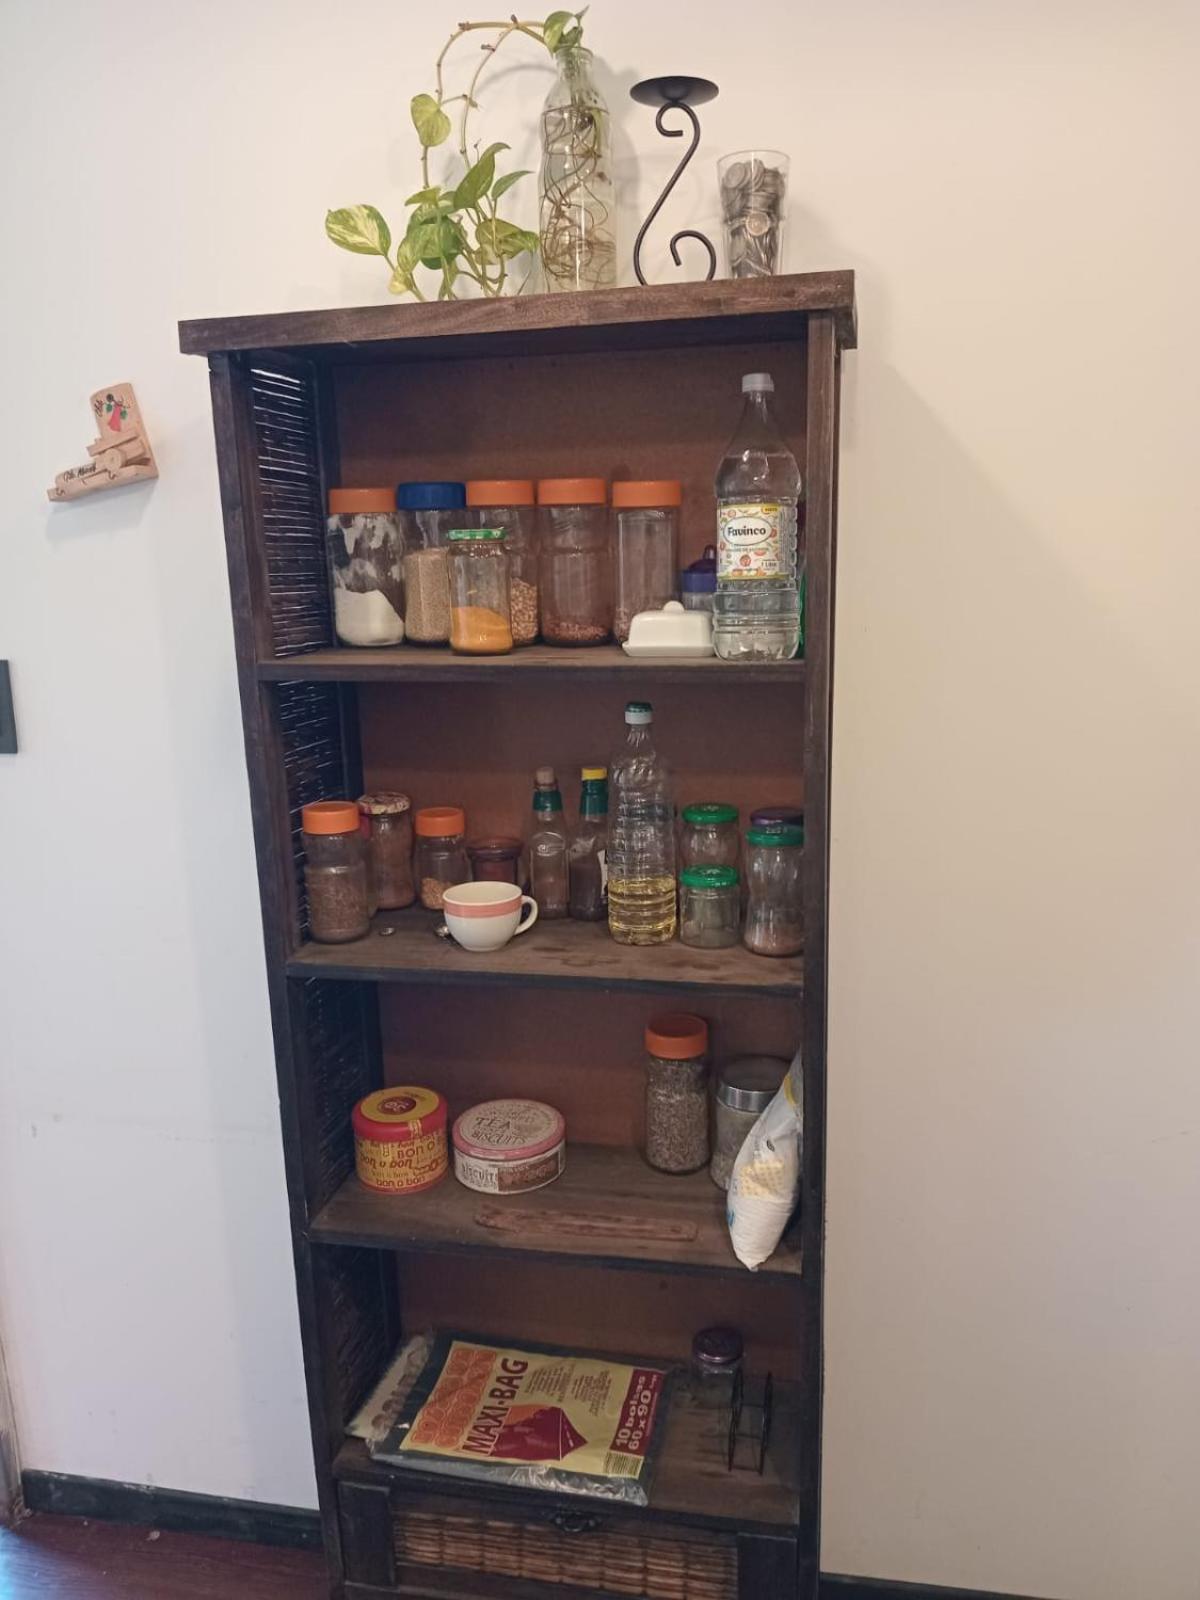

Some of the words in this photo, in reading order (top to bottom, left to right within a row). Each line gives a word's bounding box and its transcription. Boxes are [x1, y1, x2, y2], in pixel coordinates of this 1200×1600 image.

[727, 525, 767, 537] Favinco
[474, 1116, 511, 1130] TEA
[462, 1358, 529, 1456] MAXI-BAG
[628, 1431, 643, 1450] 60
[637, 1389, 652, 1416] 90
[616, 1428, 632, 1447] 10
